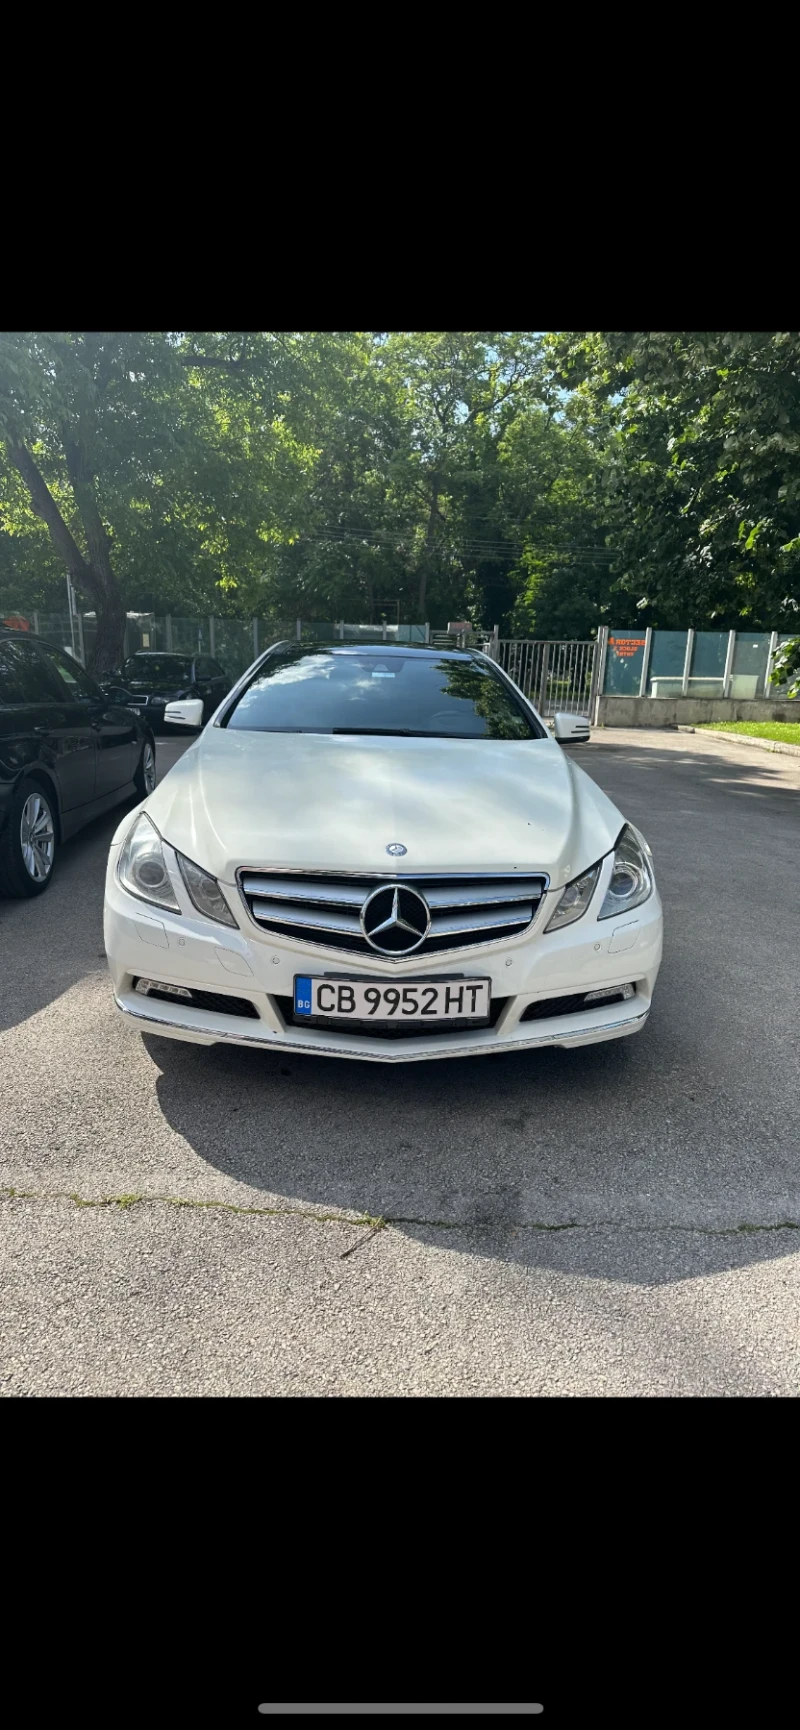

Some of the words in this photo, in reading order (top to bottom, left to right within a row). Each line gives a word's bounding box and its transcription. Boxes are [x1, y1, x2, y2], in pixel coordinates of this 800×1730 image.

[297, 999, 311, 1009] BG
[316, 983, 356, 1013] CB
[363, 987, 439, 1015] 9952
[444, 985, 484, 1014] HT
